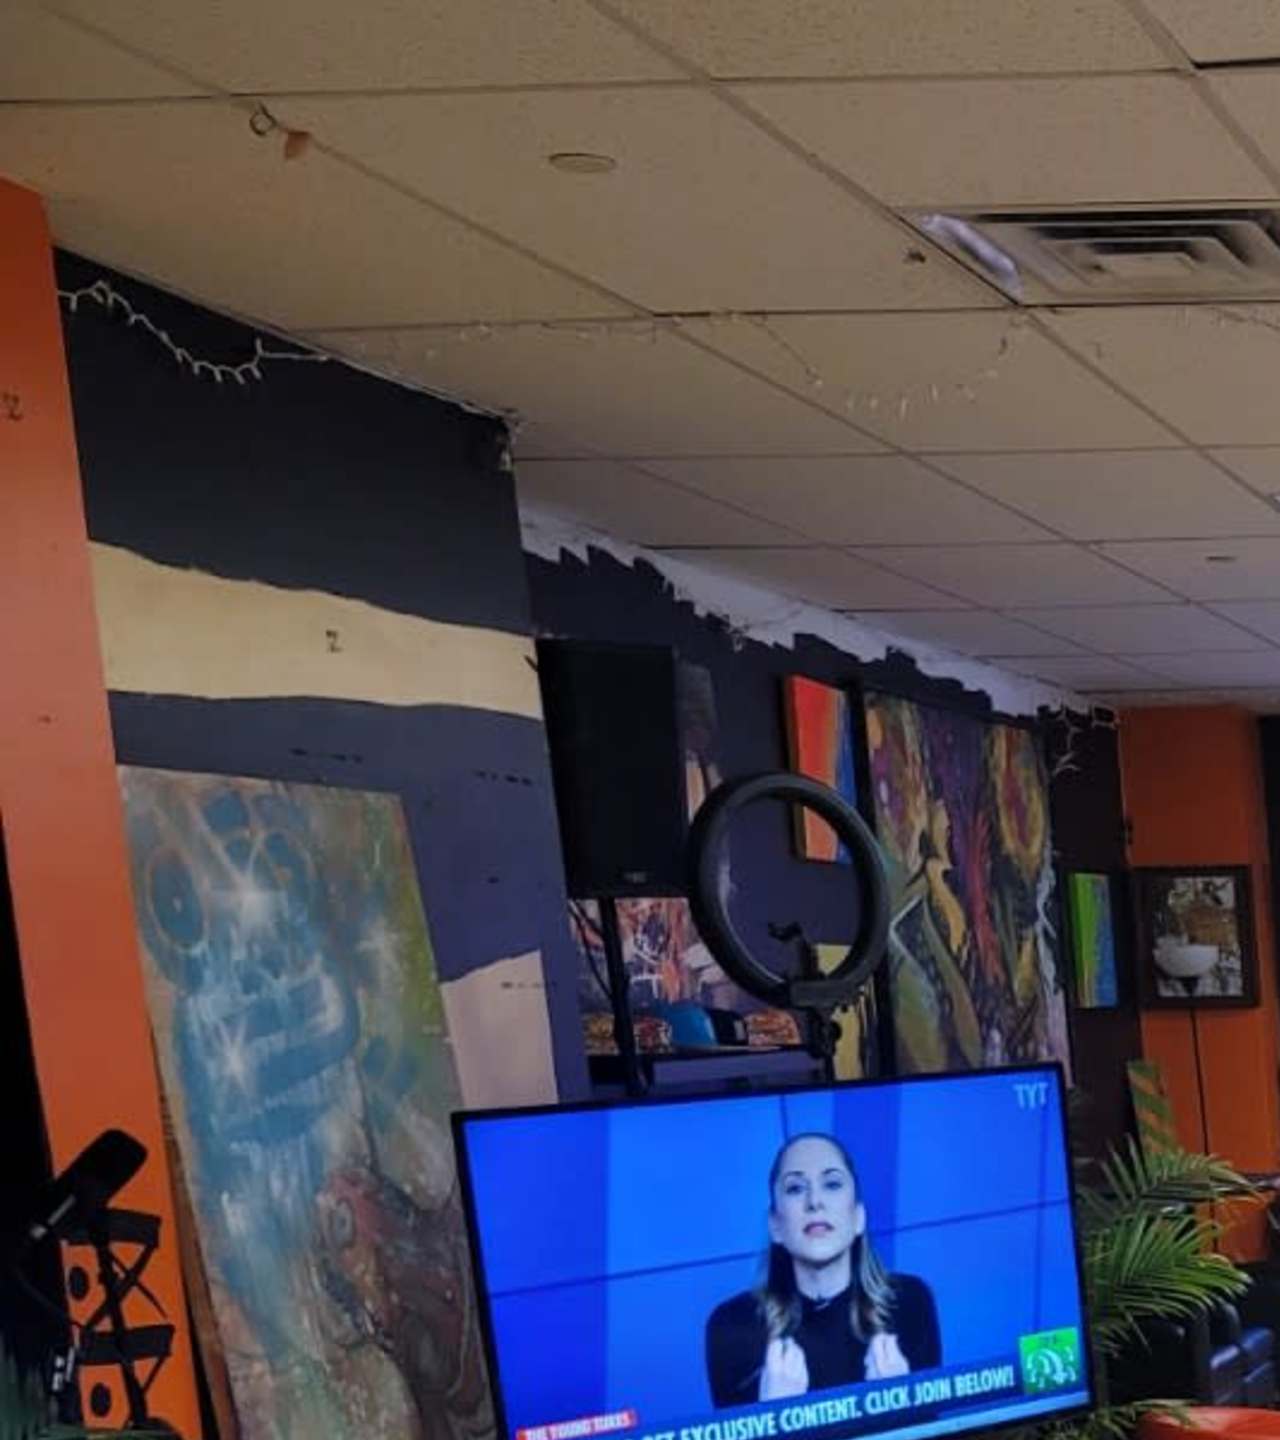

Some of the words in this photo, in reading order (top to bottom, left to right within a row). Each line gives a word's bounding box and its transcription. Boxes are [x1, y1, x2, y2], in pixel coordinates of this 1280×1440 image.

[1012, 1082, 1048, 1109] TYT
[780, 1396, 862, 1433] CONTENT.
[865, 1385, 911, 1414] CLICK
[915, 1377, 951, 1406] JOIN
[955, 1364, 1015, 1397] BELOW!
